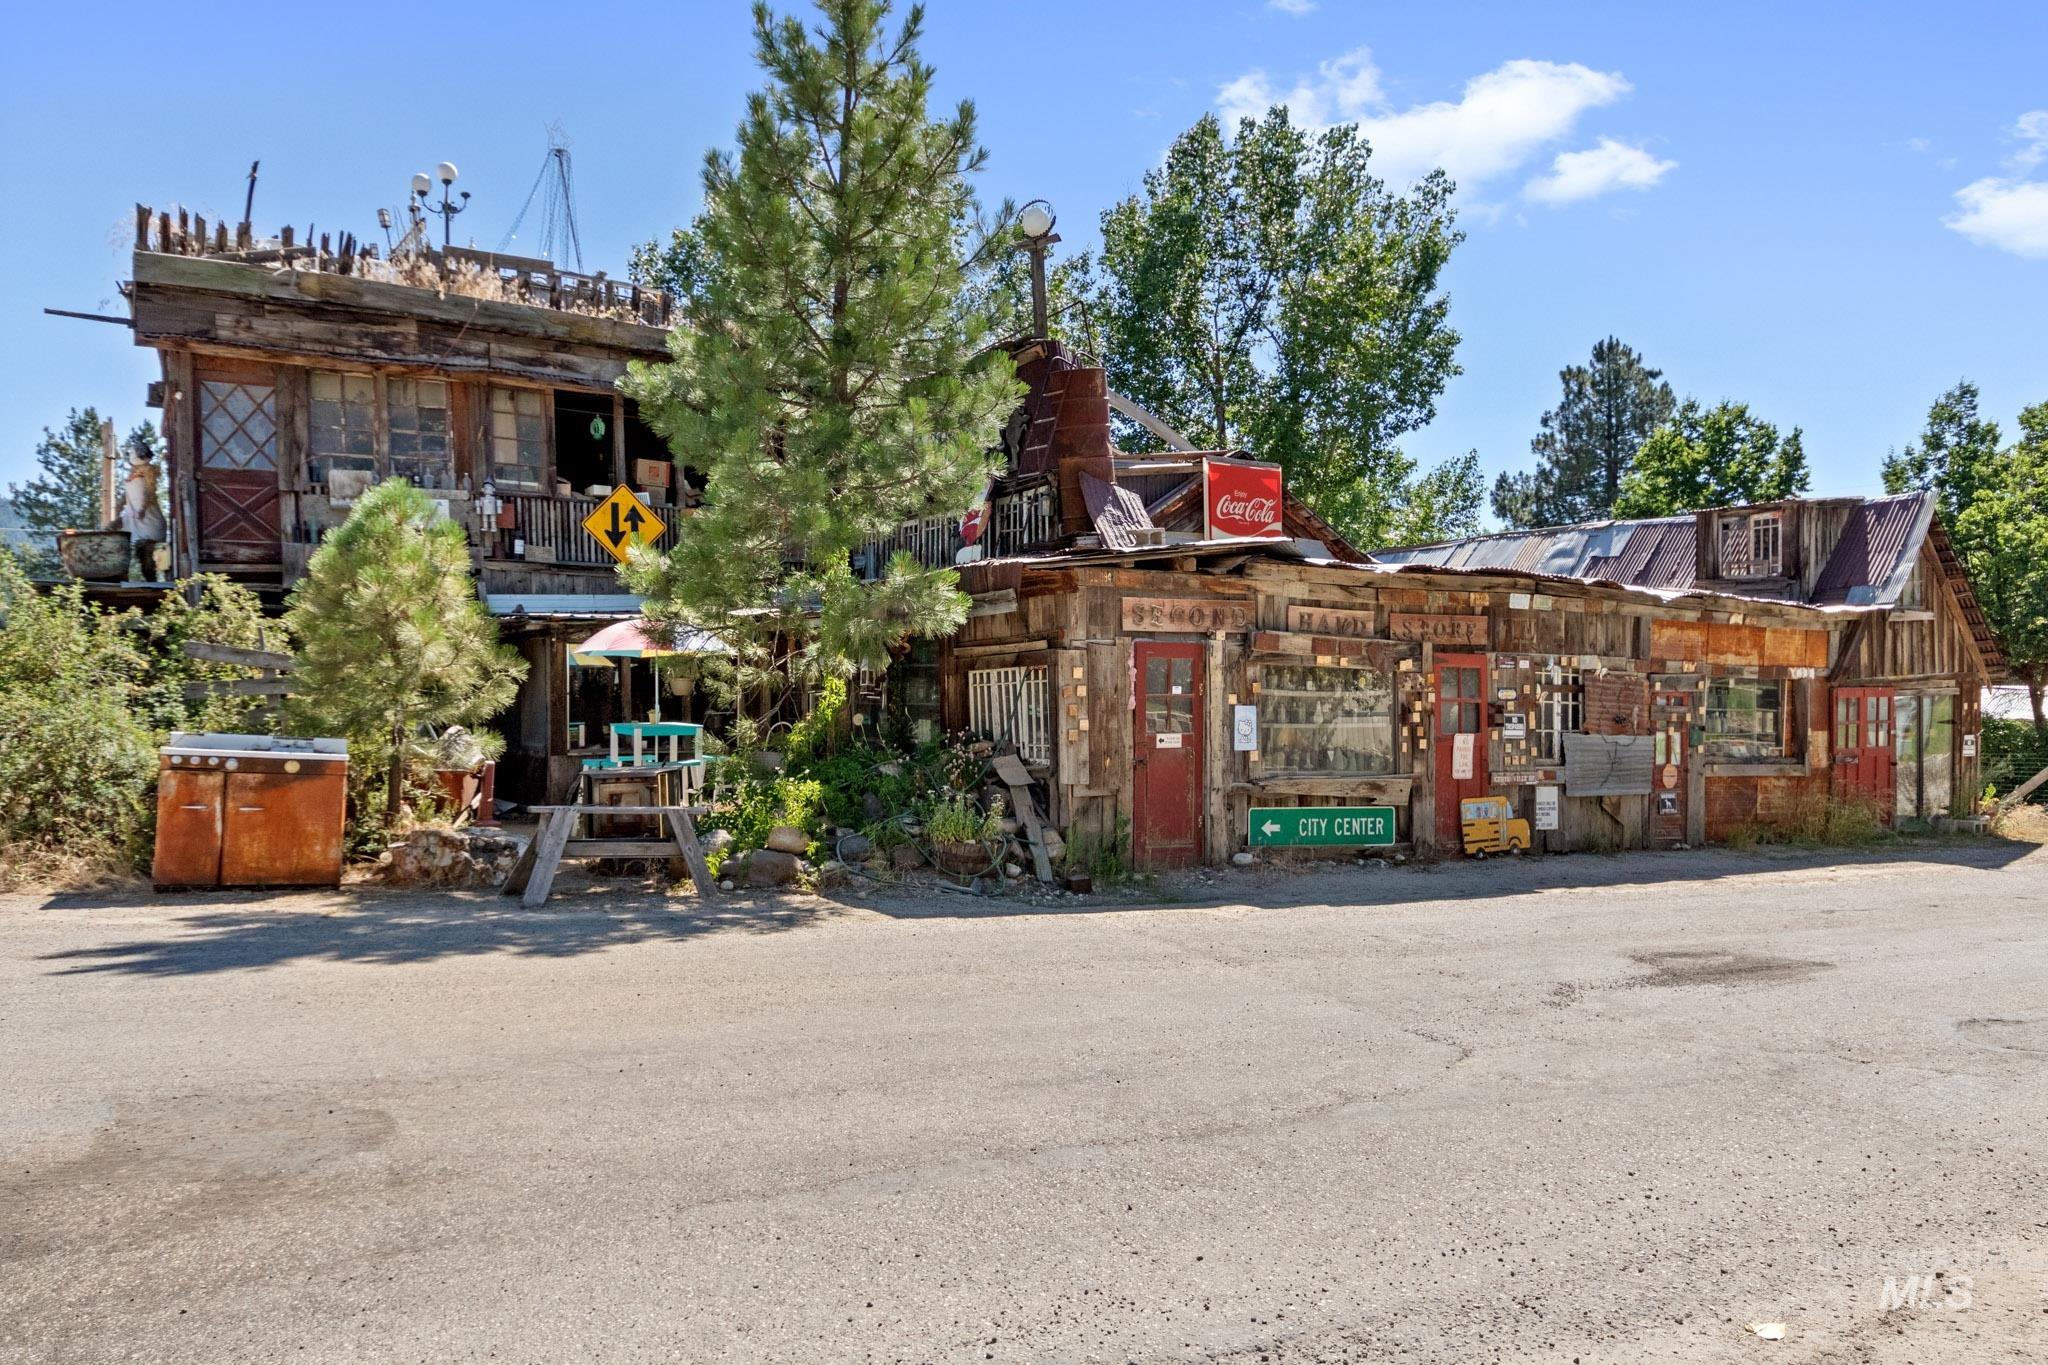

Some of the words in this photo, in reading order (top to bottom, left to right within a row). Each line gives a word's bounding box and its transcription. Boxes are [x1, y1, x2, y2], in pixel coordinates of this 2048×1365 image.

[1234, 489, 1248, 499] Enjoy
[1216, 494, 1277, 523] Coca-Cola
[1132, 603, 1247, 627] SECOND
[1299, 818, 1328, 836] CITY
[1334, 817, 1384, 836] CENTER
